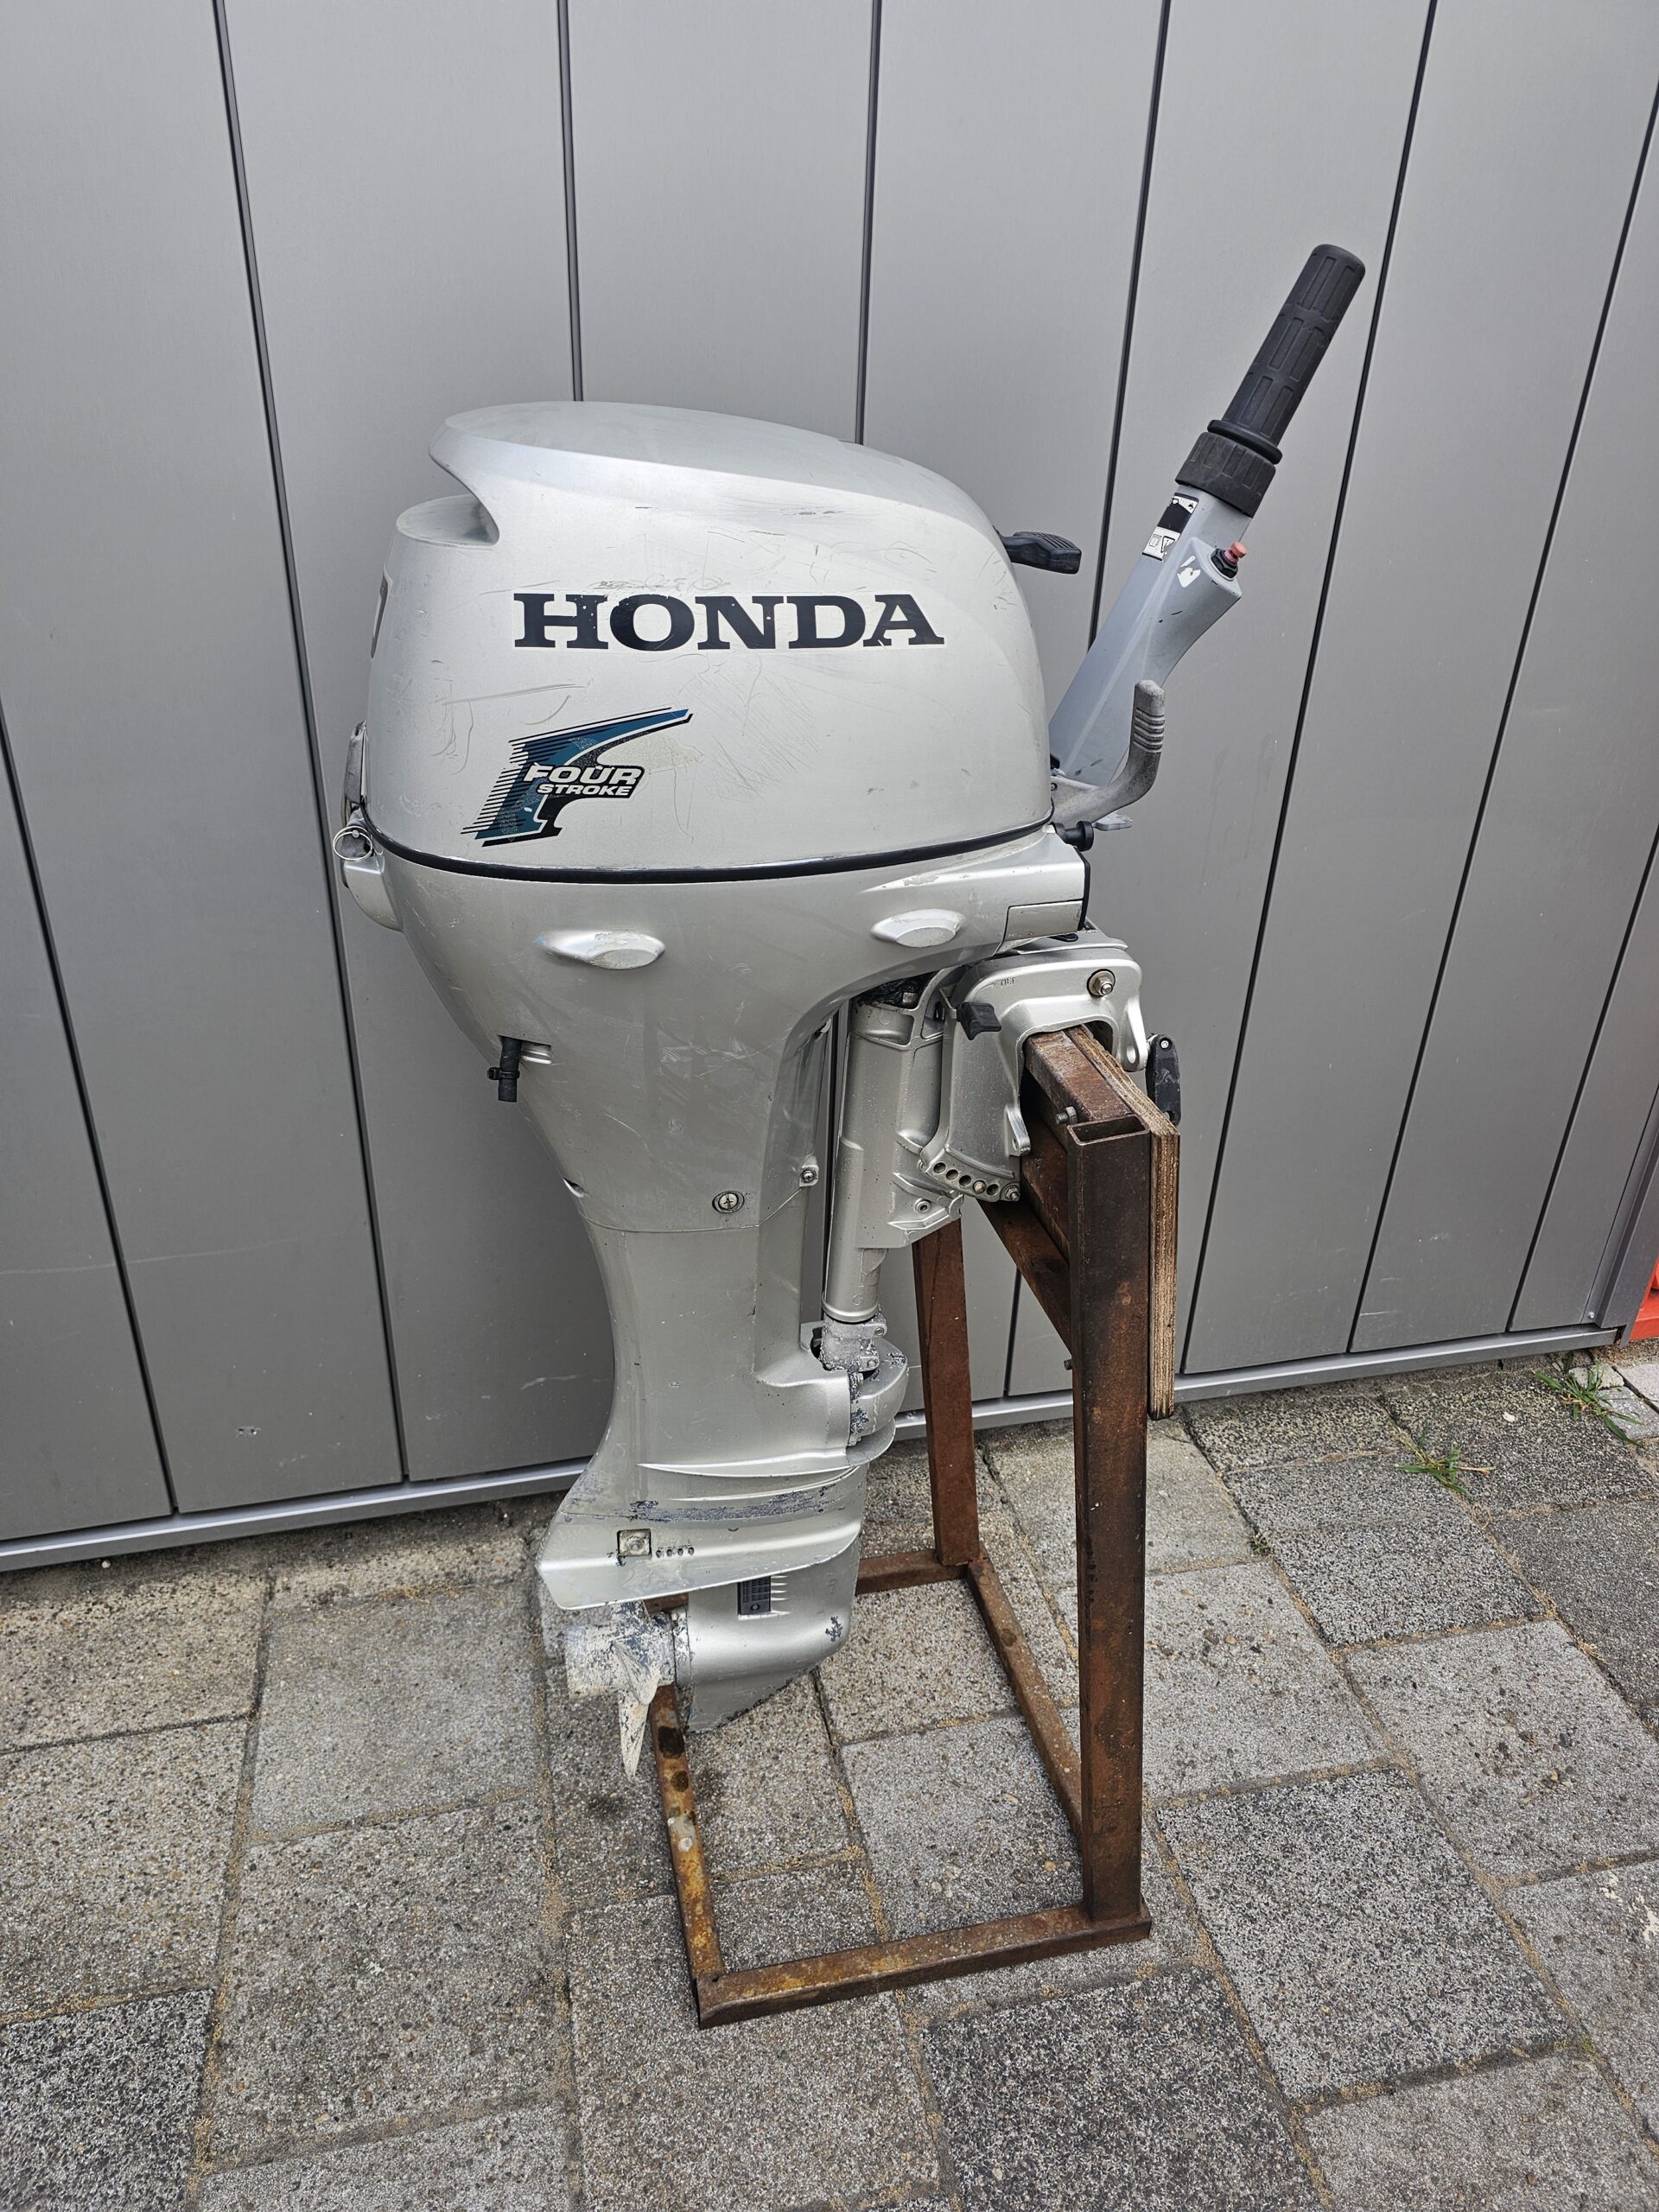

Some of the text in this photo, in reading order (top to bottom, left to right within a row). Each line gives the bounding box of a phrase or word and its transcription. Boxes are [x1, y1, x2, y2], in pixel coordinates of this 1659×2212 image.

[513, 593, 944, 652] HONDA
[523, 764, 642, 785] FOUR
[537, 783, 632, 796] STROKE
